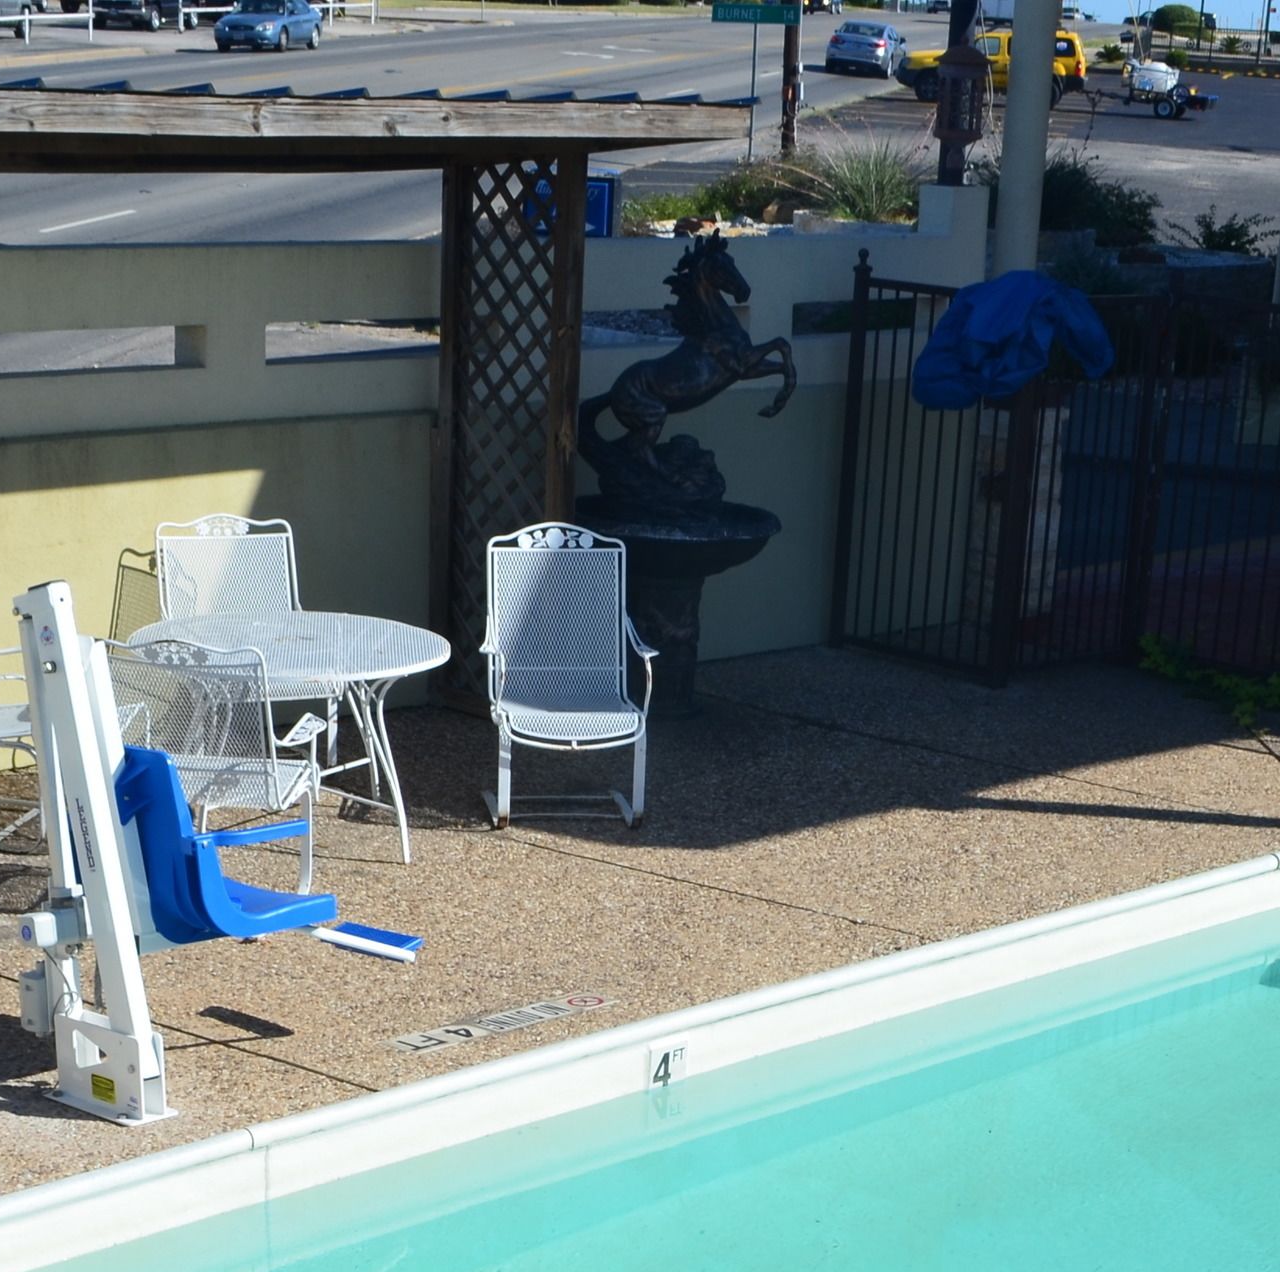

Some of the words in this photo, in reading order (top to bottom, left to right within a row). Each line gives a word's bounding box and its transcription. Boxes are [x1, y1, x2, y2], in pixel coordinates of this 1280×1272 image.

[717, 7, 763, 20] BURNET
[783, 9, 795, 20] 14
[531, 1002, 571, 1016] NO
[476, 1010, 545, 1031] DIVING
[443, 1027, 474, 1038] 4
[396, 1034, 448, 1051] FT
[652, 1051, 672, 1088] 4
[672, 1046, 686, 1063] FT
